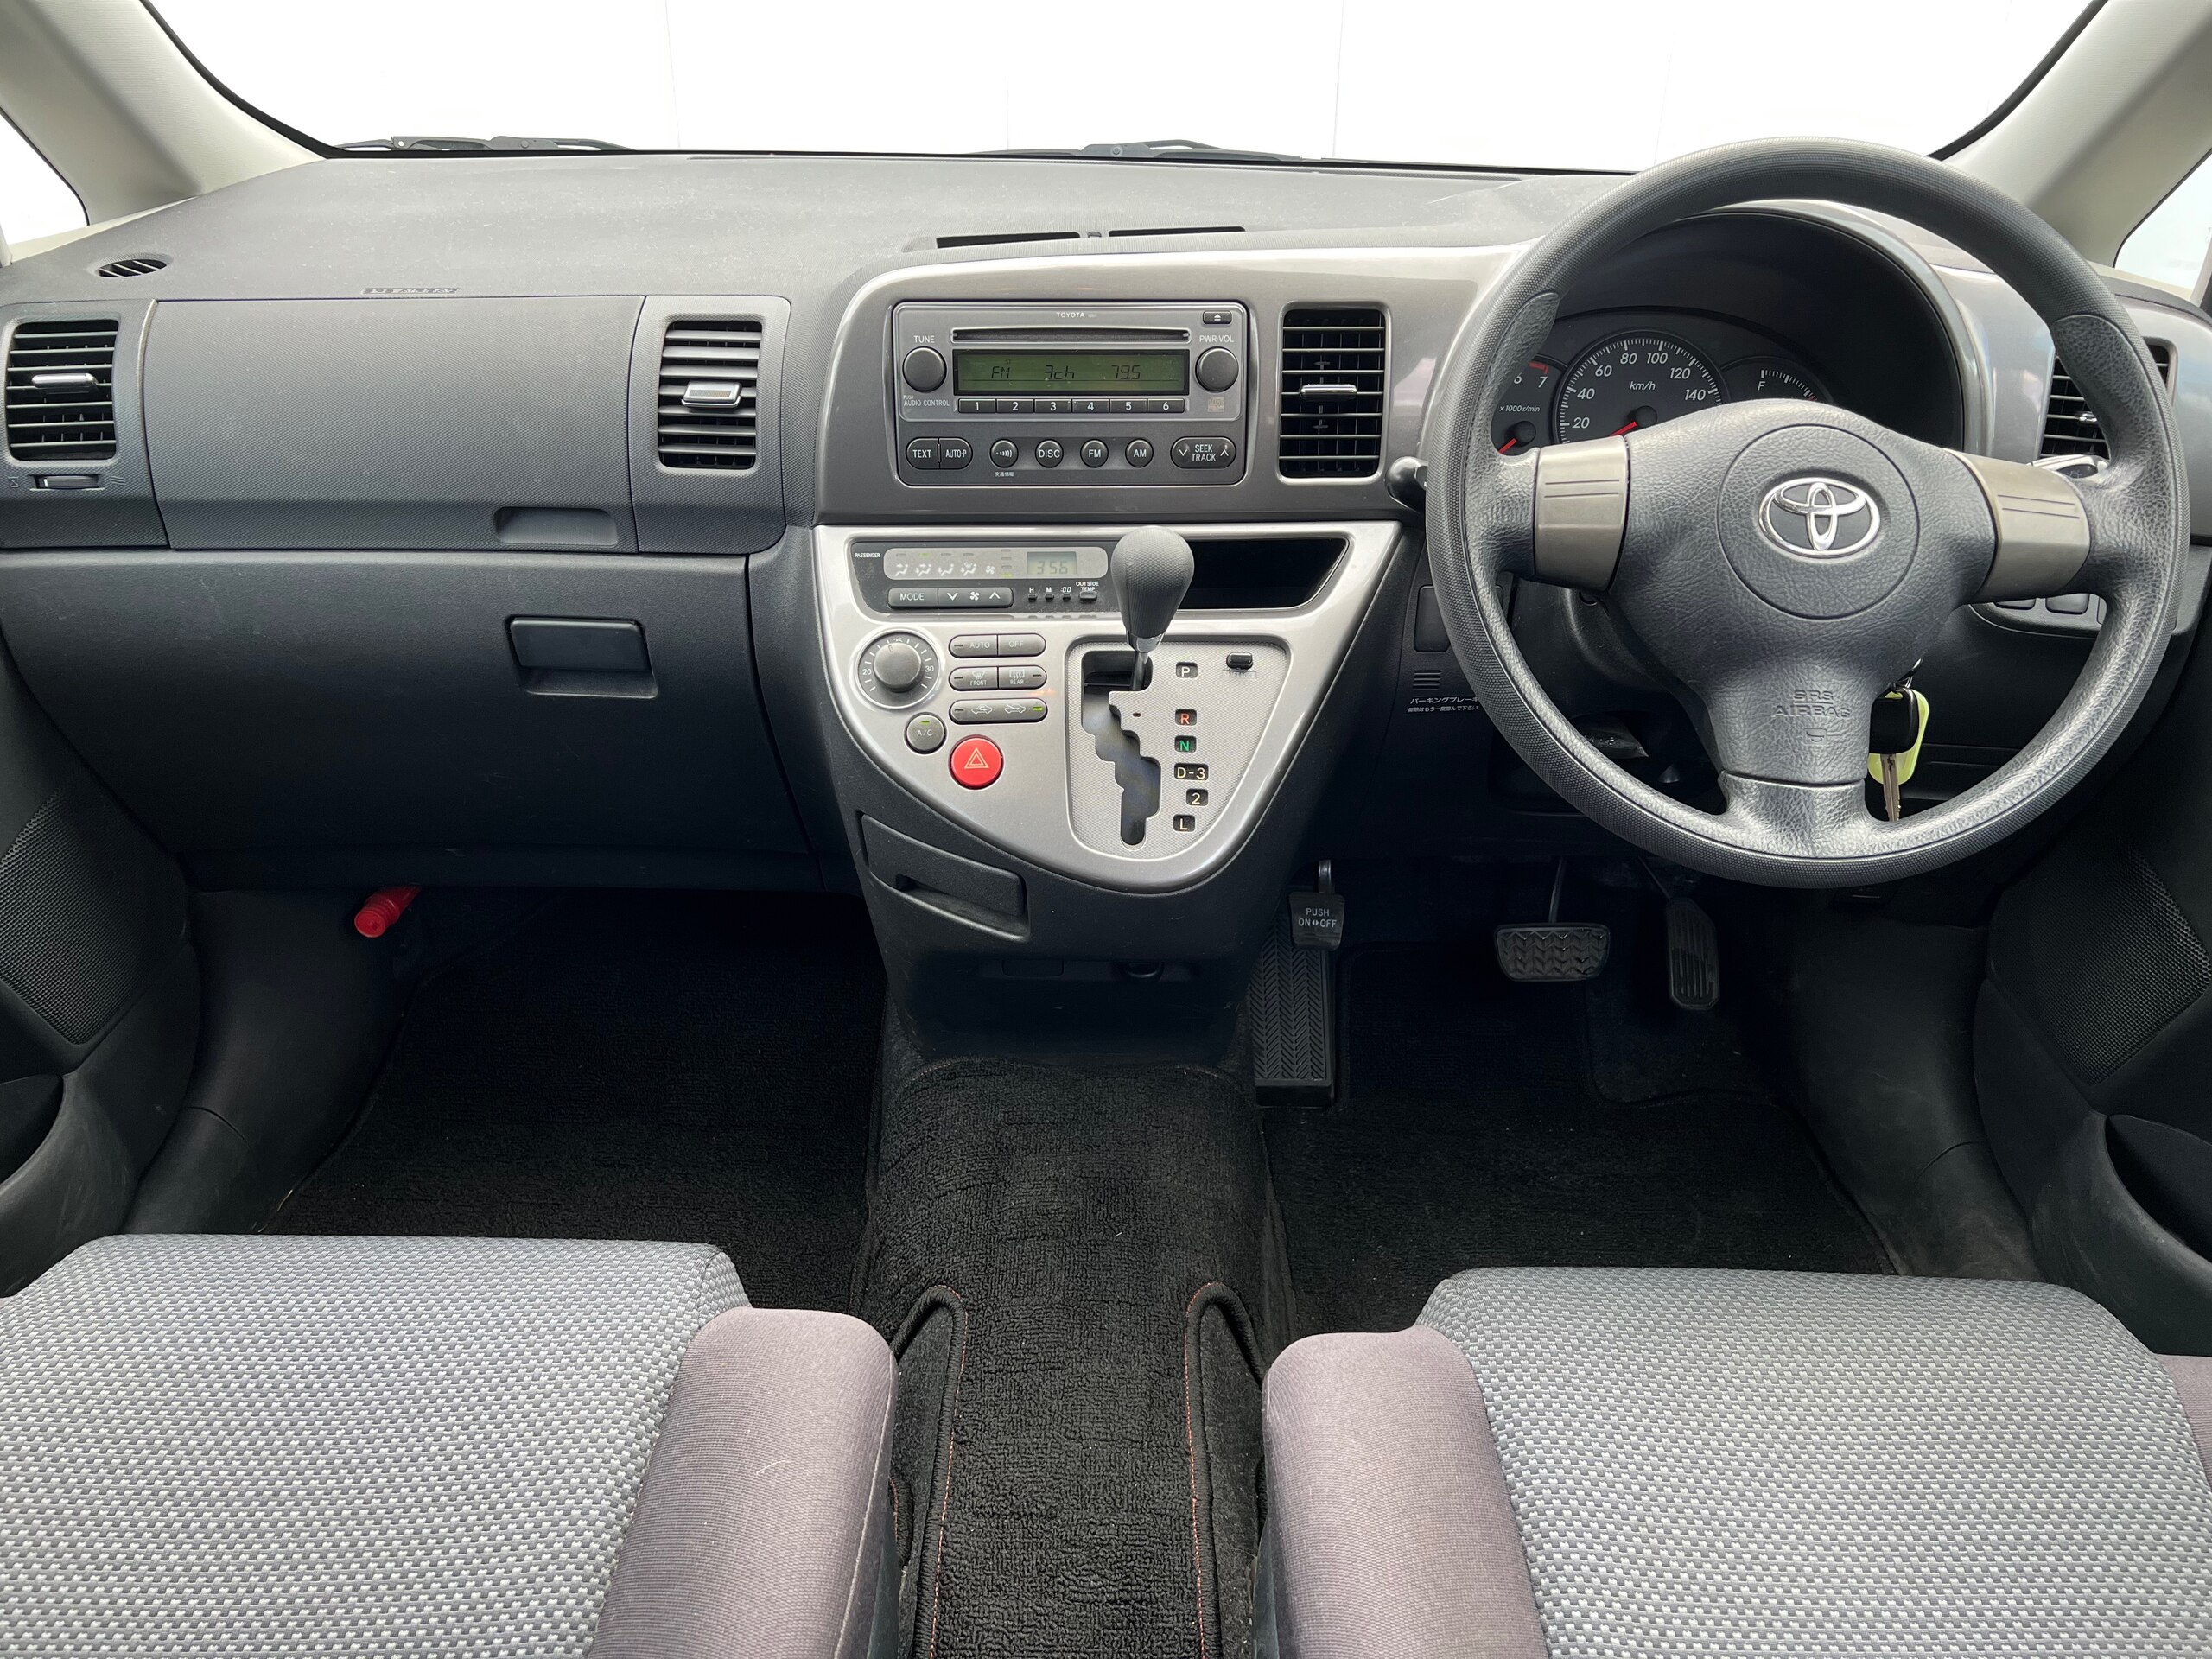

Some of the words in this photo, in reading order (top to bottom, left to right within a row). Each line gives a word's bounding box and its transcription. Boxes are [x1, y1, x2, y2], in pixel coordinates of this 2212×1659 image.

[1620, 353, 1637, 365] 80
[1646, 353, 1669, 365] 100
[991, 366, 1010, 378] FM
[1044, 365, 1075, 379] 3ch
[1594, 365, 1612, 377] 60
[1669, 367, 1692, 380] 120
[1538, 376, 1548, 388] 7
[1629, 380, 1656, 391] km/h
[1758, 381, 1766, 391] F
[1577, 388, 1595, 400] 40
[1684, 390, 1707, 402] 140
[975, 402, 980, 411] 1
[1012, 402, 1018, 411] 2
[1050, 402, 1057, 411] 3
[1087, 402, 1095, 411] 4
[1125, 402, 1132, 411] 5
[1162, 402, 1169, 411] 6
[1572, 417, 1590, 429] 20
[912, 449, 931, 458] TEXT
[1039, 449, 1060, 459] DISC
[1089, 449, 1102, 459] FM
[1133, 449, 1147, 458] AM
[1194, 444, 1213, 453] SEEK
[1191, 453, 1217, 462] TRACK
[899, 592, 925, 601] MODE
[1181, 666, 1191, 677] P
[1793, 690, 1834, 701] SRS
[1771, 705, 1852, 718] AIRBAG
[1180, 713, 1190, 724] R
[1179, 740, 1190, 752] N
[1177, 767, 1205, 779] D-3
[1192, 792, 1201, 804] 2
[1179, 818, 1188, 830] L
[1306, 907, 1330, 916] PUSH
[1298, 918, 1311, 926] ON
[1319, 918, 1337, 928] OFF
